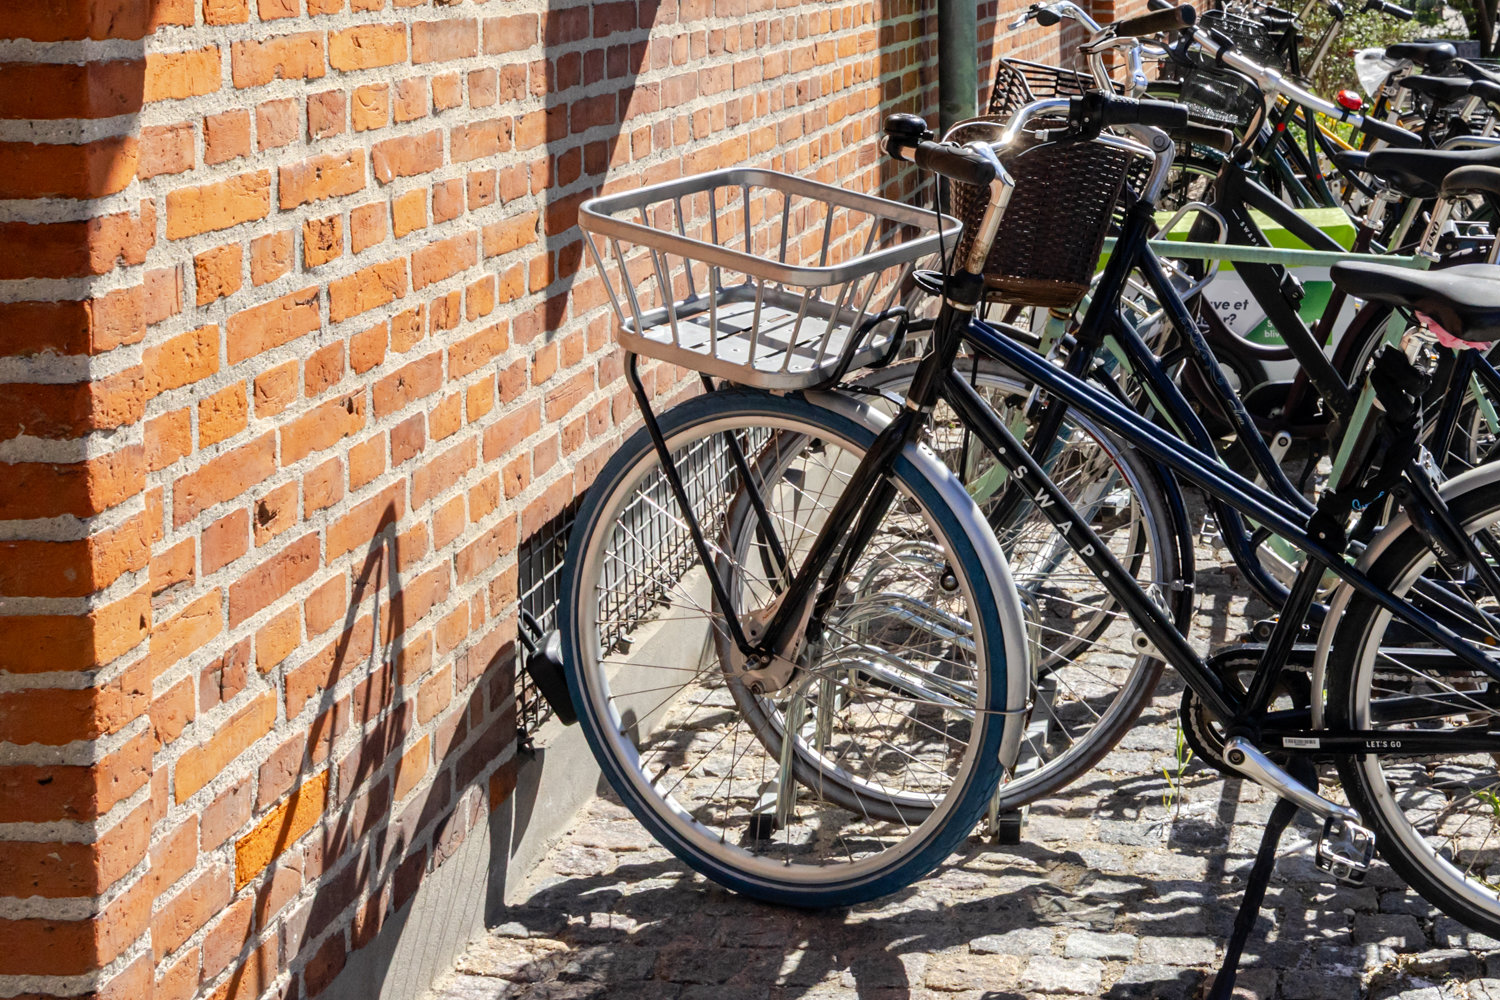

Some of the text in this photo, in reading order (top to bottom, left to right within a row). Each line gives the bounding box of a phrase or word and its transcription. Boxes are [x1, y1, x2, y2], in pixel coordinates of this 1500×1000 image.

[1233, 300, 1249, 310] et
[1366, 740, 1402, 748] LET'S GO
